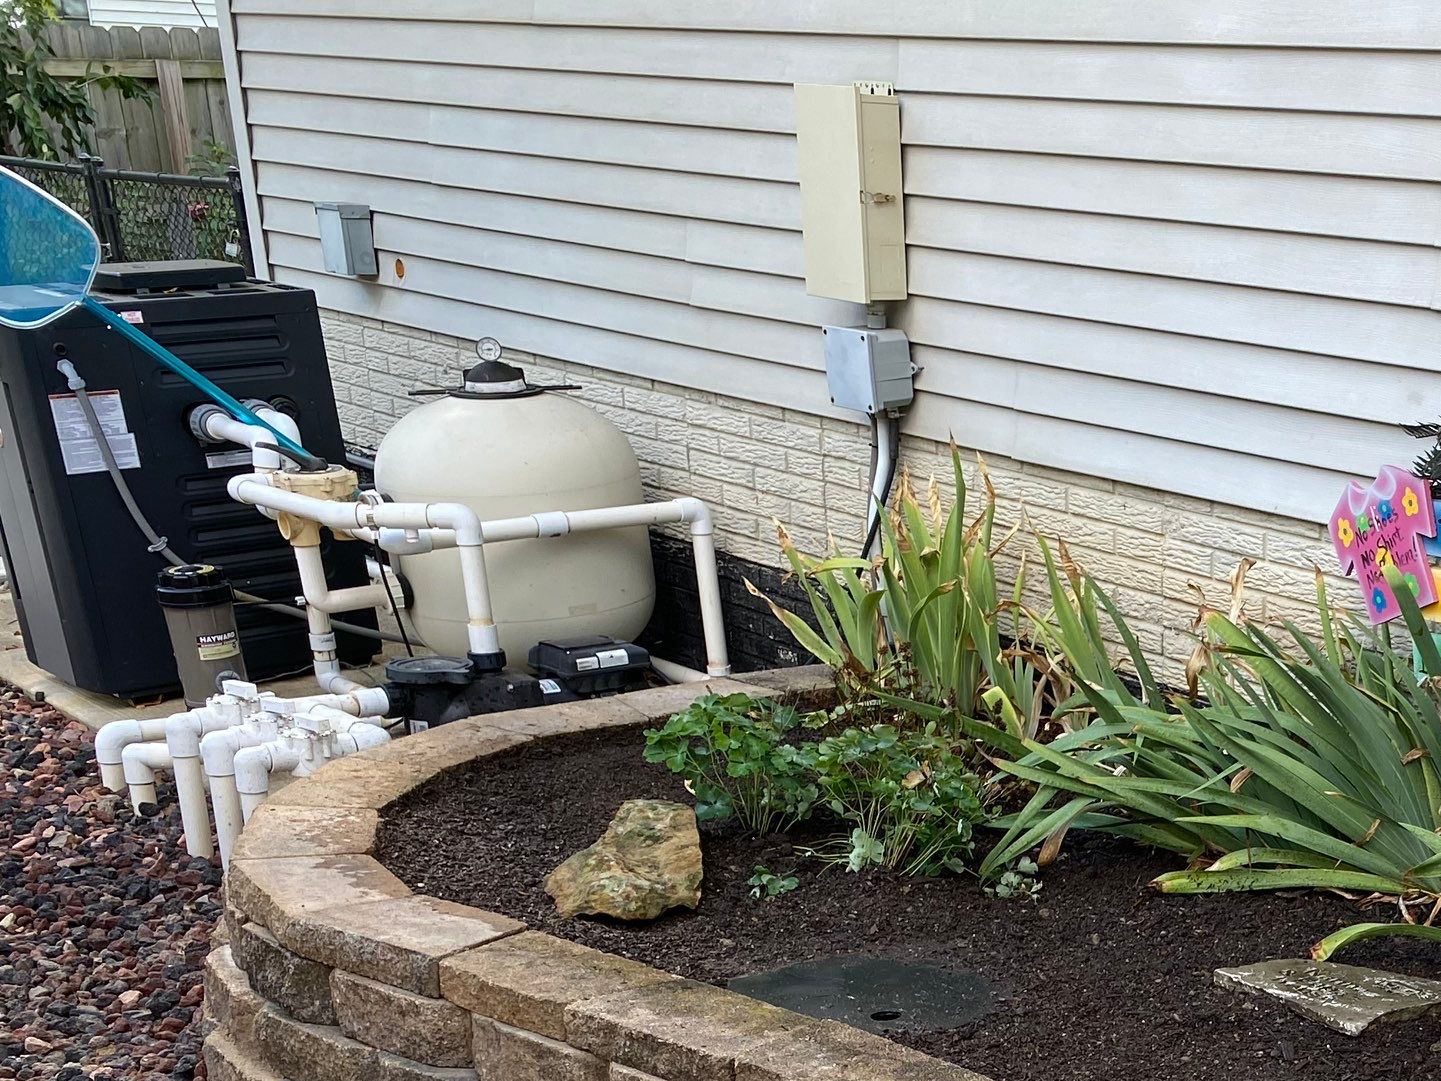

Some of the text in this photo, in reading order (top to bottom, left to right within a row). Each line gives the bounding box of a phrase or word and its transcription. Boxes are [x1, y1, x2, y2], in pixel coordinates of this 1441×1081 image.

[1355, 508, 1399, 548] No Shoes
[1377, 526, 1404, 557] Shirt
[199, 631, 236, 643] HAYWARD
